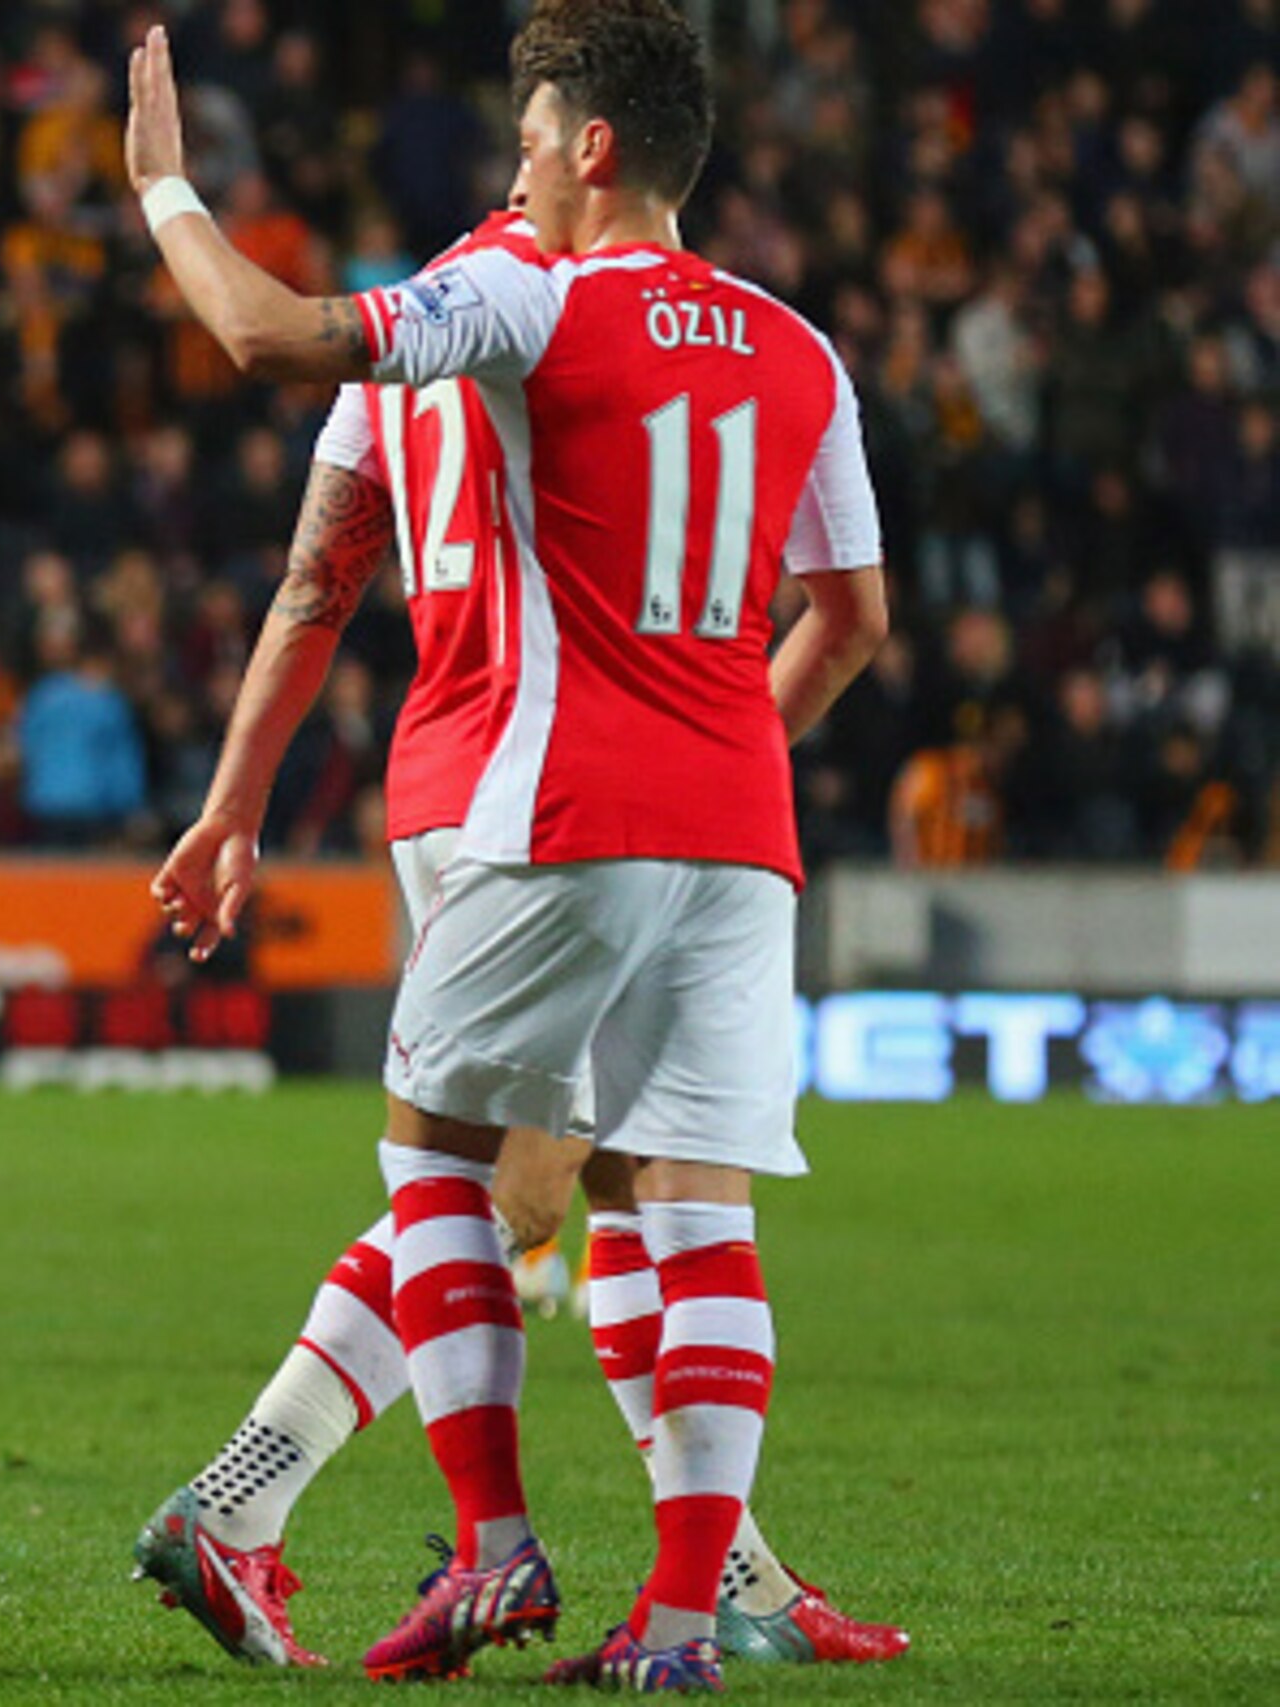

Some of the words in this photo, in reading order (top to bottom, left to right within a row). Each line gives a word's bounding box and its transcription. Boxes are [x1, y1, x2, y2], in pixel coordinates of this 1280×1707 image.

[641, 286, 756, 355] ÖZIL
[379, 378, 475, 597] 12
[635, 392, 758, 638] 11
